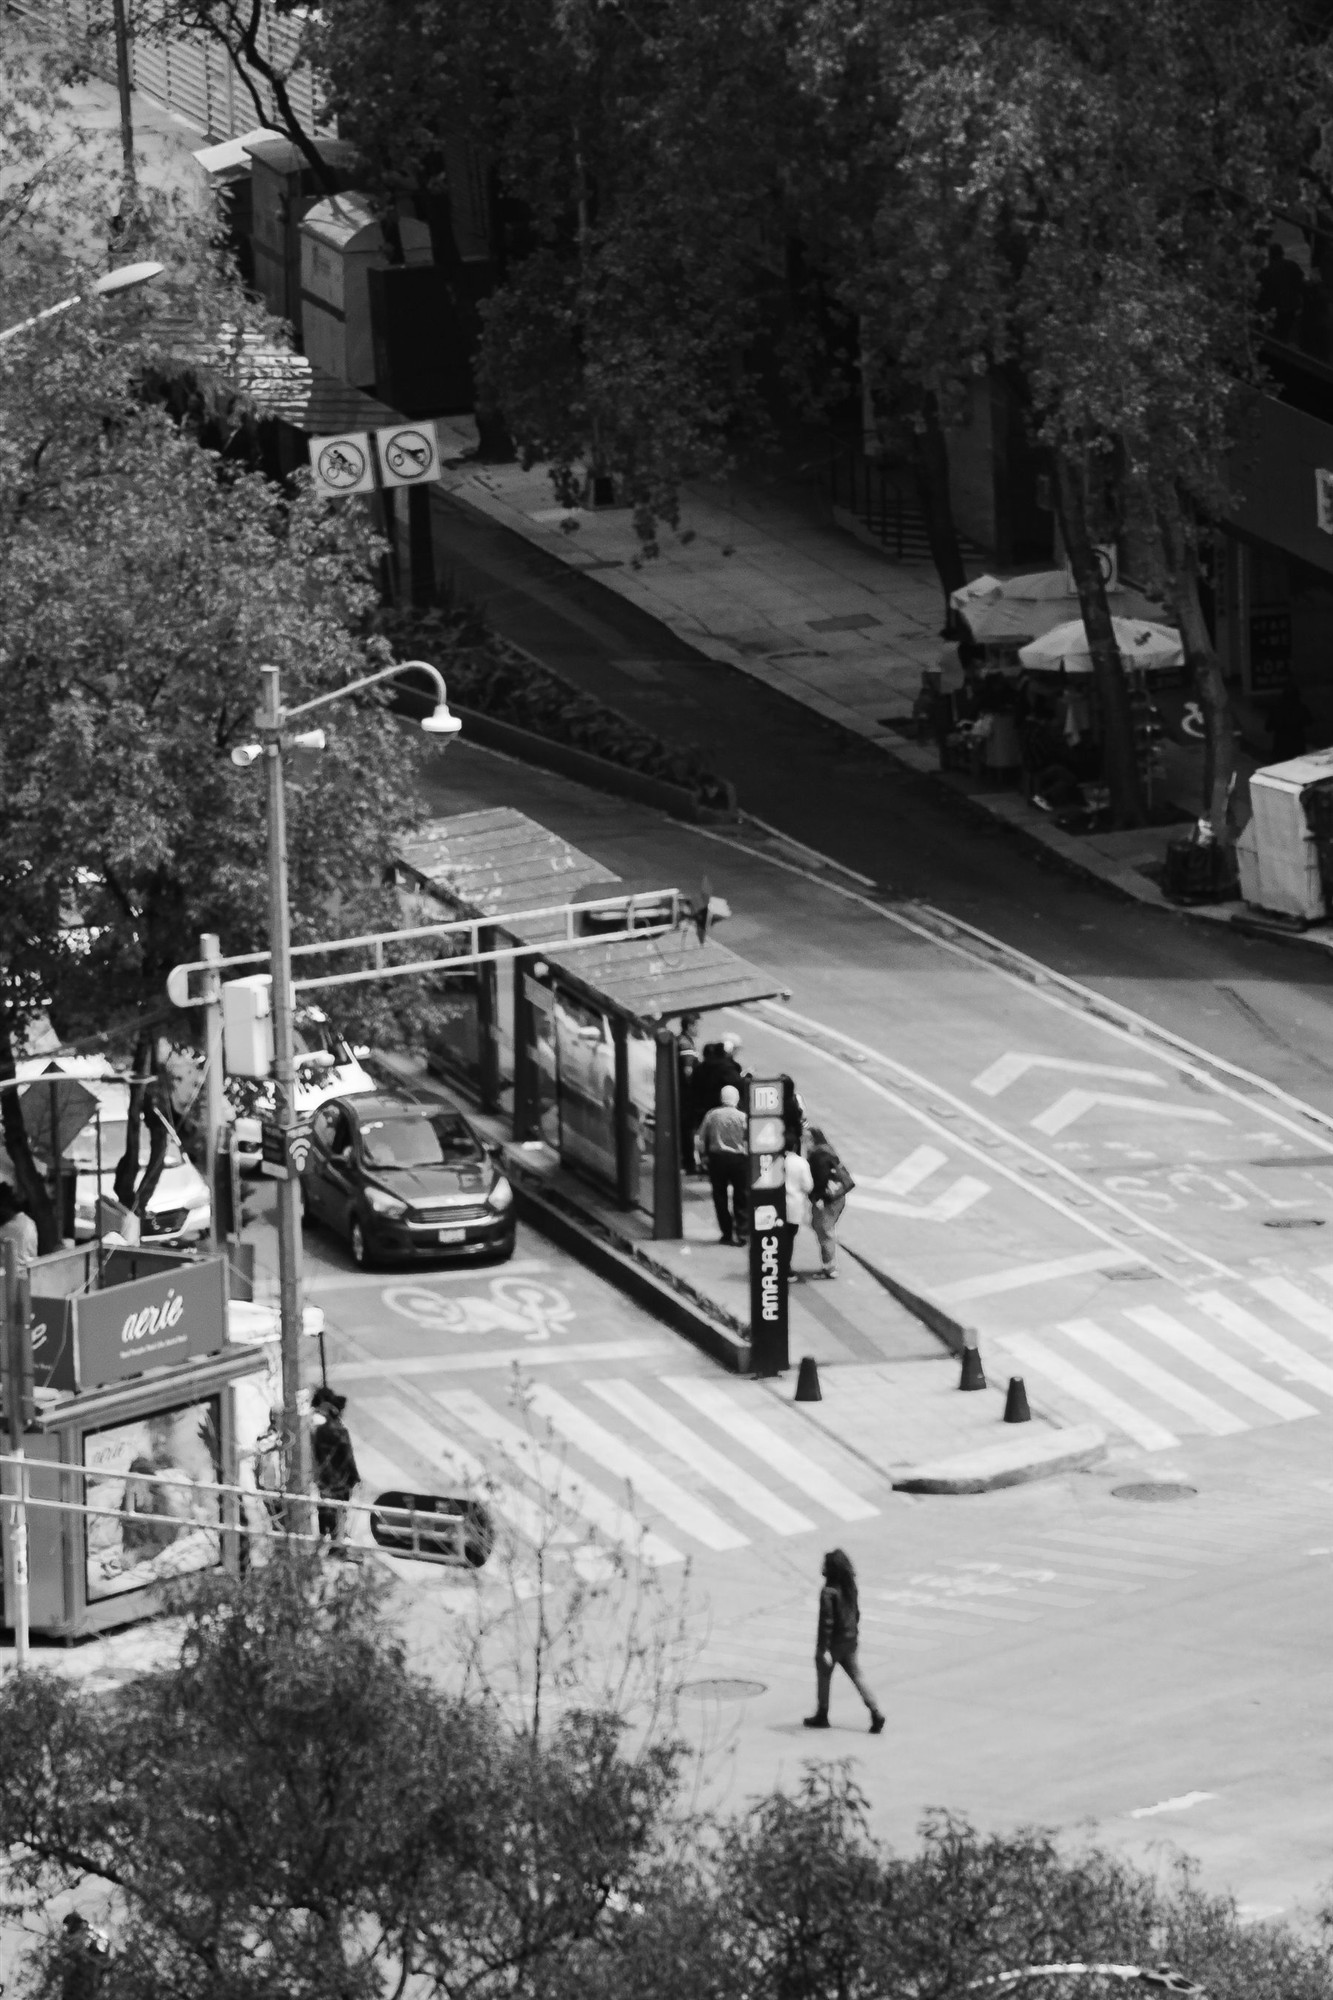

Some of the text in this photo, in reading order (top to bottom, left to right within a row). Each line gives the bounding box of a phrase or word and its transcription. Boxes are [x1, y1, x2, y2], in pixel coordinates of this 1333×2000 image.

[755, 1122, 777, 1145] 4
[761, 1235, 779, 1321] AMAJAC
[121, 1288, 184, 1343] aerie
